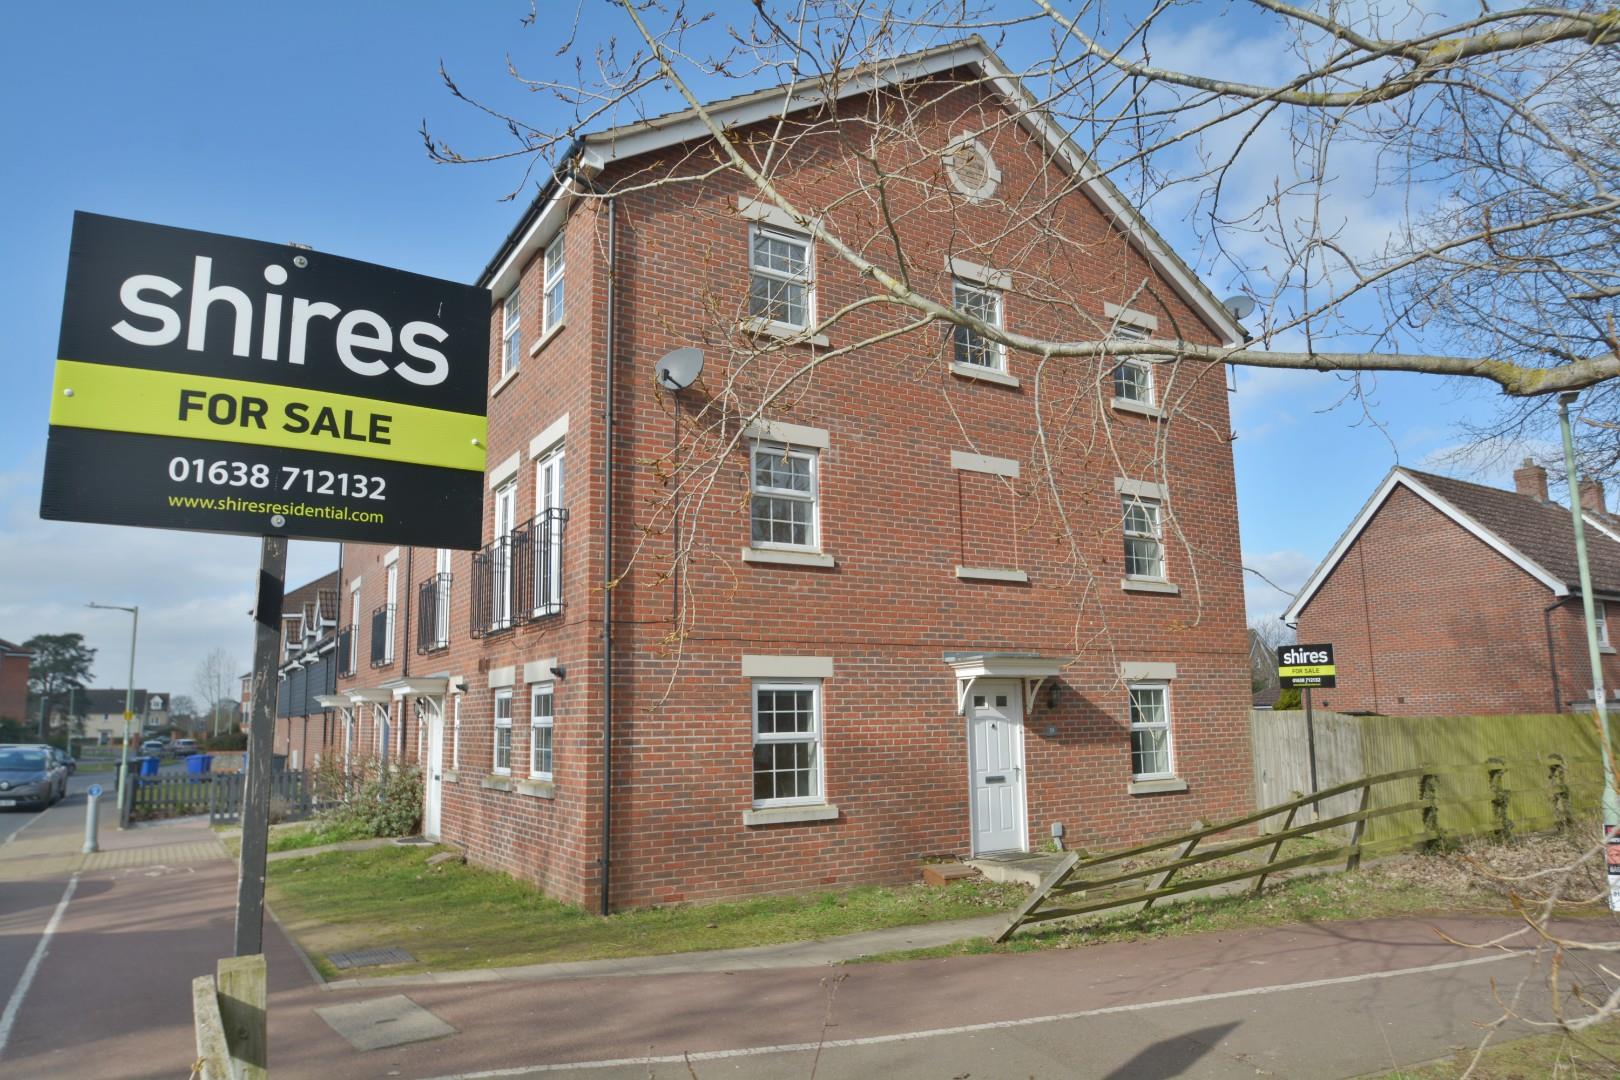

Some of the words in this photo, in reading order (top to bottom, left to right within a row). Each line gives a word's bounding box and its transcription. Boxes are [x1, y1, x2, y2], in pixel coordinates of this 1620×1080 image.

[111, 256, 449, 386] shires
[178, 389, 269, 429] FOR
[282, 402, 393, 446] SALE
[168, 456, 270, 489] 01638
[281, 467, 387, 500] 712132
[168, 495, 385, 524] www.shiresresidential.com
[1283, 648, 1328, 664] shires
